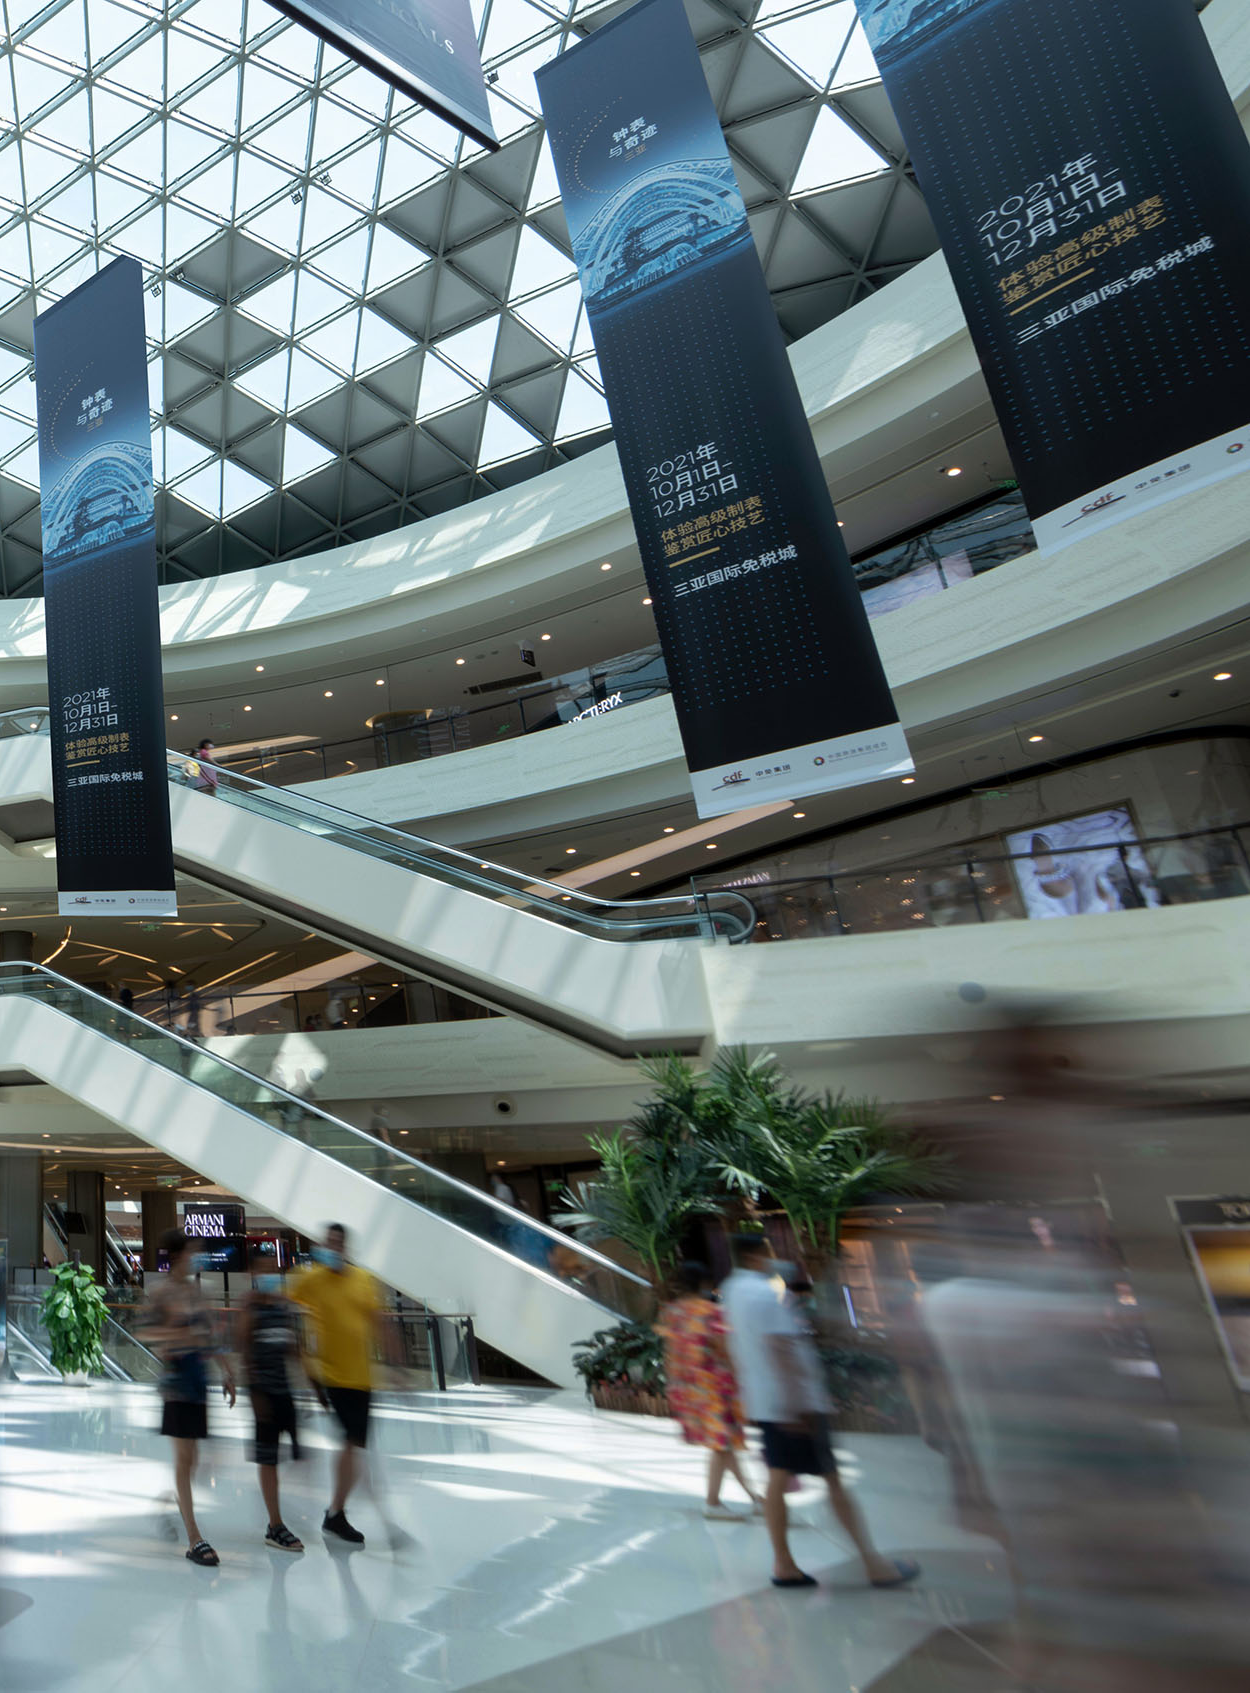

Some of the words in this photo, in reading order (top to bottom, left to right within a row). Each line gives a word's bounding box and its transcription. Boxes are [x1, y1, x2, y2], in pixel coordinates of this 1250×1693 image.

[608, 122, 658, 159] 与奇迹
[612, 116, 646, 143] 钟表
[977, 152, 1097, 232] 2021年
[986, 180, 1127, 265] 12月31日
[998, 194, 1163, 292] 体验高级制表
[1002, 210, 1167, 305] 鉴赏匠心技艺
[1017, 235, 1215, 345] 三亚国际免税城
[76, 398, 114, 426] 与奇迹
[81, 387, 106, 411] 钟表
[646, 441, 719, 483] 2021年
[653, 473, 739, 519] 12月31日
[1080, 491, 1115, 513] cdf
[660, 495, 763, 543] 体验高级制表
[663, 510, 766, 558] 鉴赏匠心技艺
[673, 544, 798, 598] 三亚国际免税城
[62, 687, 111, 708] 2021年
[63, 713, 119, 734] 12月31日
[65, 732, 130, 751] 体验高级制表
[65, 742, 130, 761] 鉴赏匠心技艺
[67, 771, 143, 788] 三亚国际免税城
[722, 771, 743, 784] cdf
[184, 1214, 225, 1225] ARMANI
[184, 1225, 226, 1237] CINEMA
